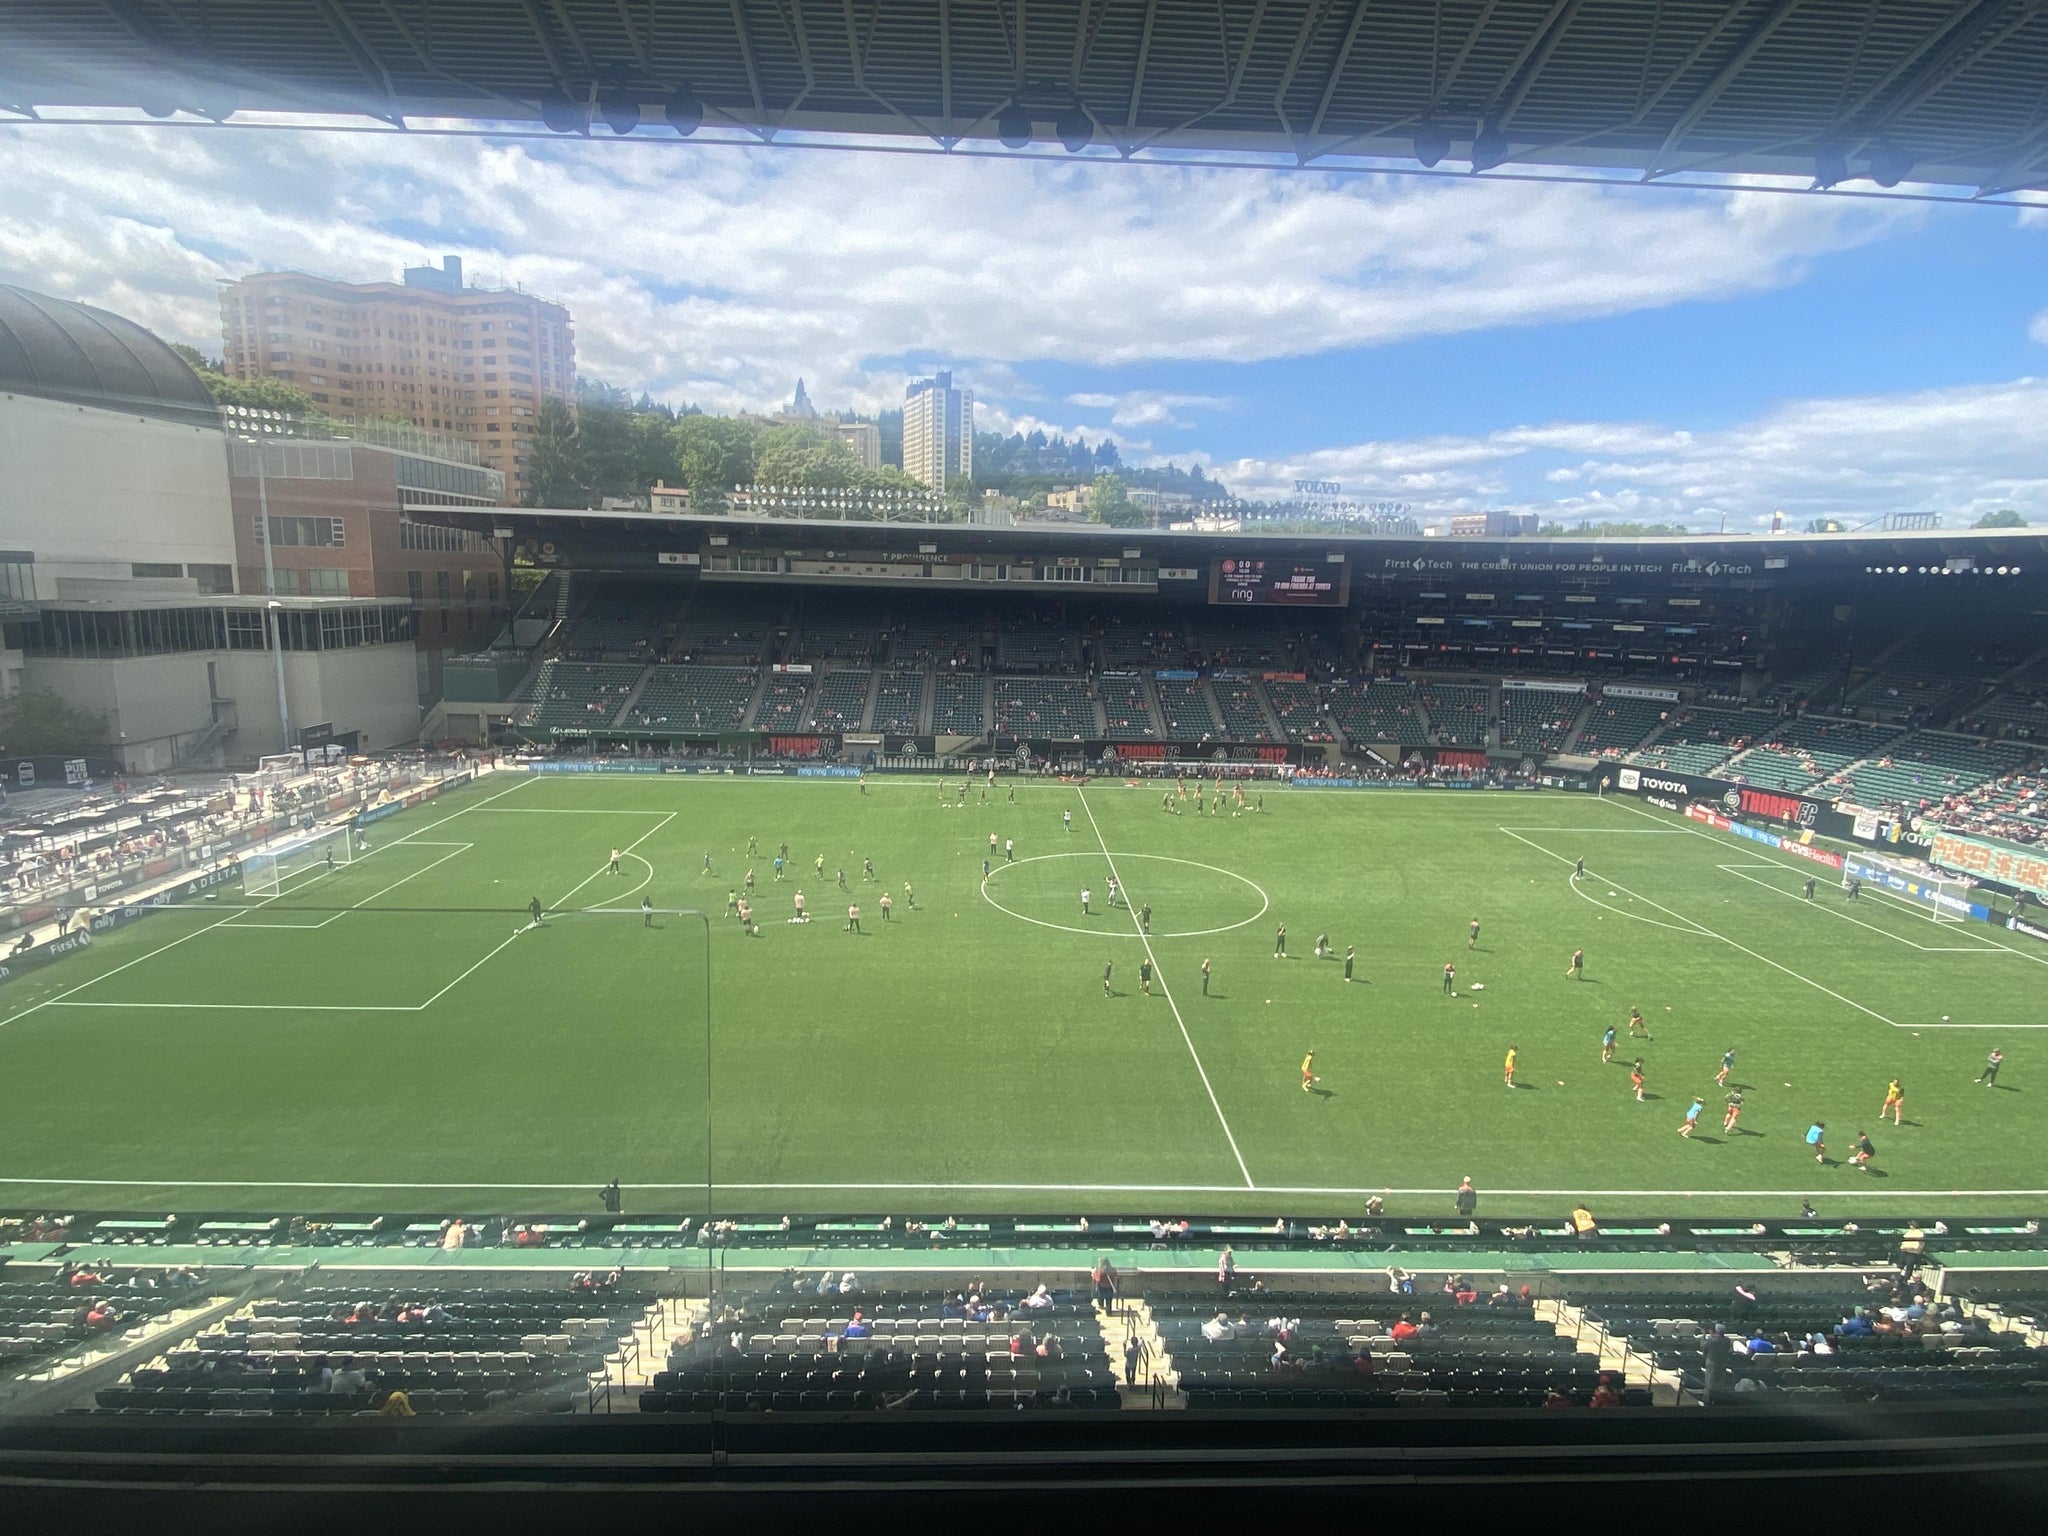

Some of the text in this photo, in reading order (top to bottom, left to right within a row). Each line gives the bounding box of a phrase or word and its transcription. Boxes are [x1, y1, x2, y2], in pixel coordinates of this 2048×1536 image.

[1294, 480, 1341, 494] VOLVO
[891, 553, 949, 563] PROVIDENCE
[1385, 559, 1452, 569] First Tech
[1461, 562, 1479, 570] THE
[1520, 563, 1552, 571] UNION
[1555, 563, 1576, 571] FOR
[1579, 564, 1617, 572] PEOPLE
[1620, 564, 1632, 572] IN
[1634, 565, 1662, 573] TECH
[1672, 563, 1751, 574] First Tech
[1231, 590, 1253, 601] ring
[769, 737, 835, 757] THORNS FC
[1117, 745, 1180, 761] THORNS FC
[1232, 746, 1287, 763] EST 2012
[65, 763, 87, 773] PUB
[814, 769, 827, 777] ring
[832, 769, 845, 777] ring
[847, 769, 861, 777] ring
[1642, 777, 1688, 795] TOYOTA
[1647, 795, 1677, 810] First Tech
[1741, 790, 1818, 826] THORNS FC
[201, 868, 238, 888] DELTA
[98, 879, 124, 893] TOYOTA
[153, 892, 172, 906] ally
[95, 914, 116, 929] ally
[50, 937, 78, 956] First
